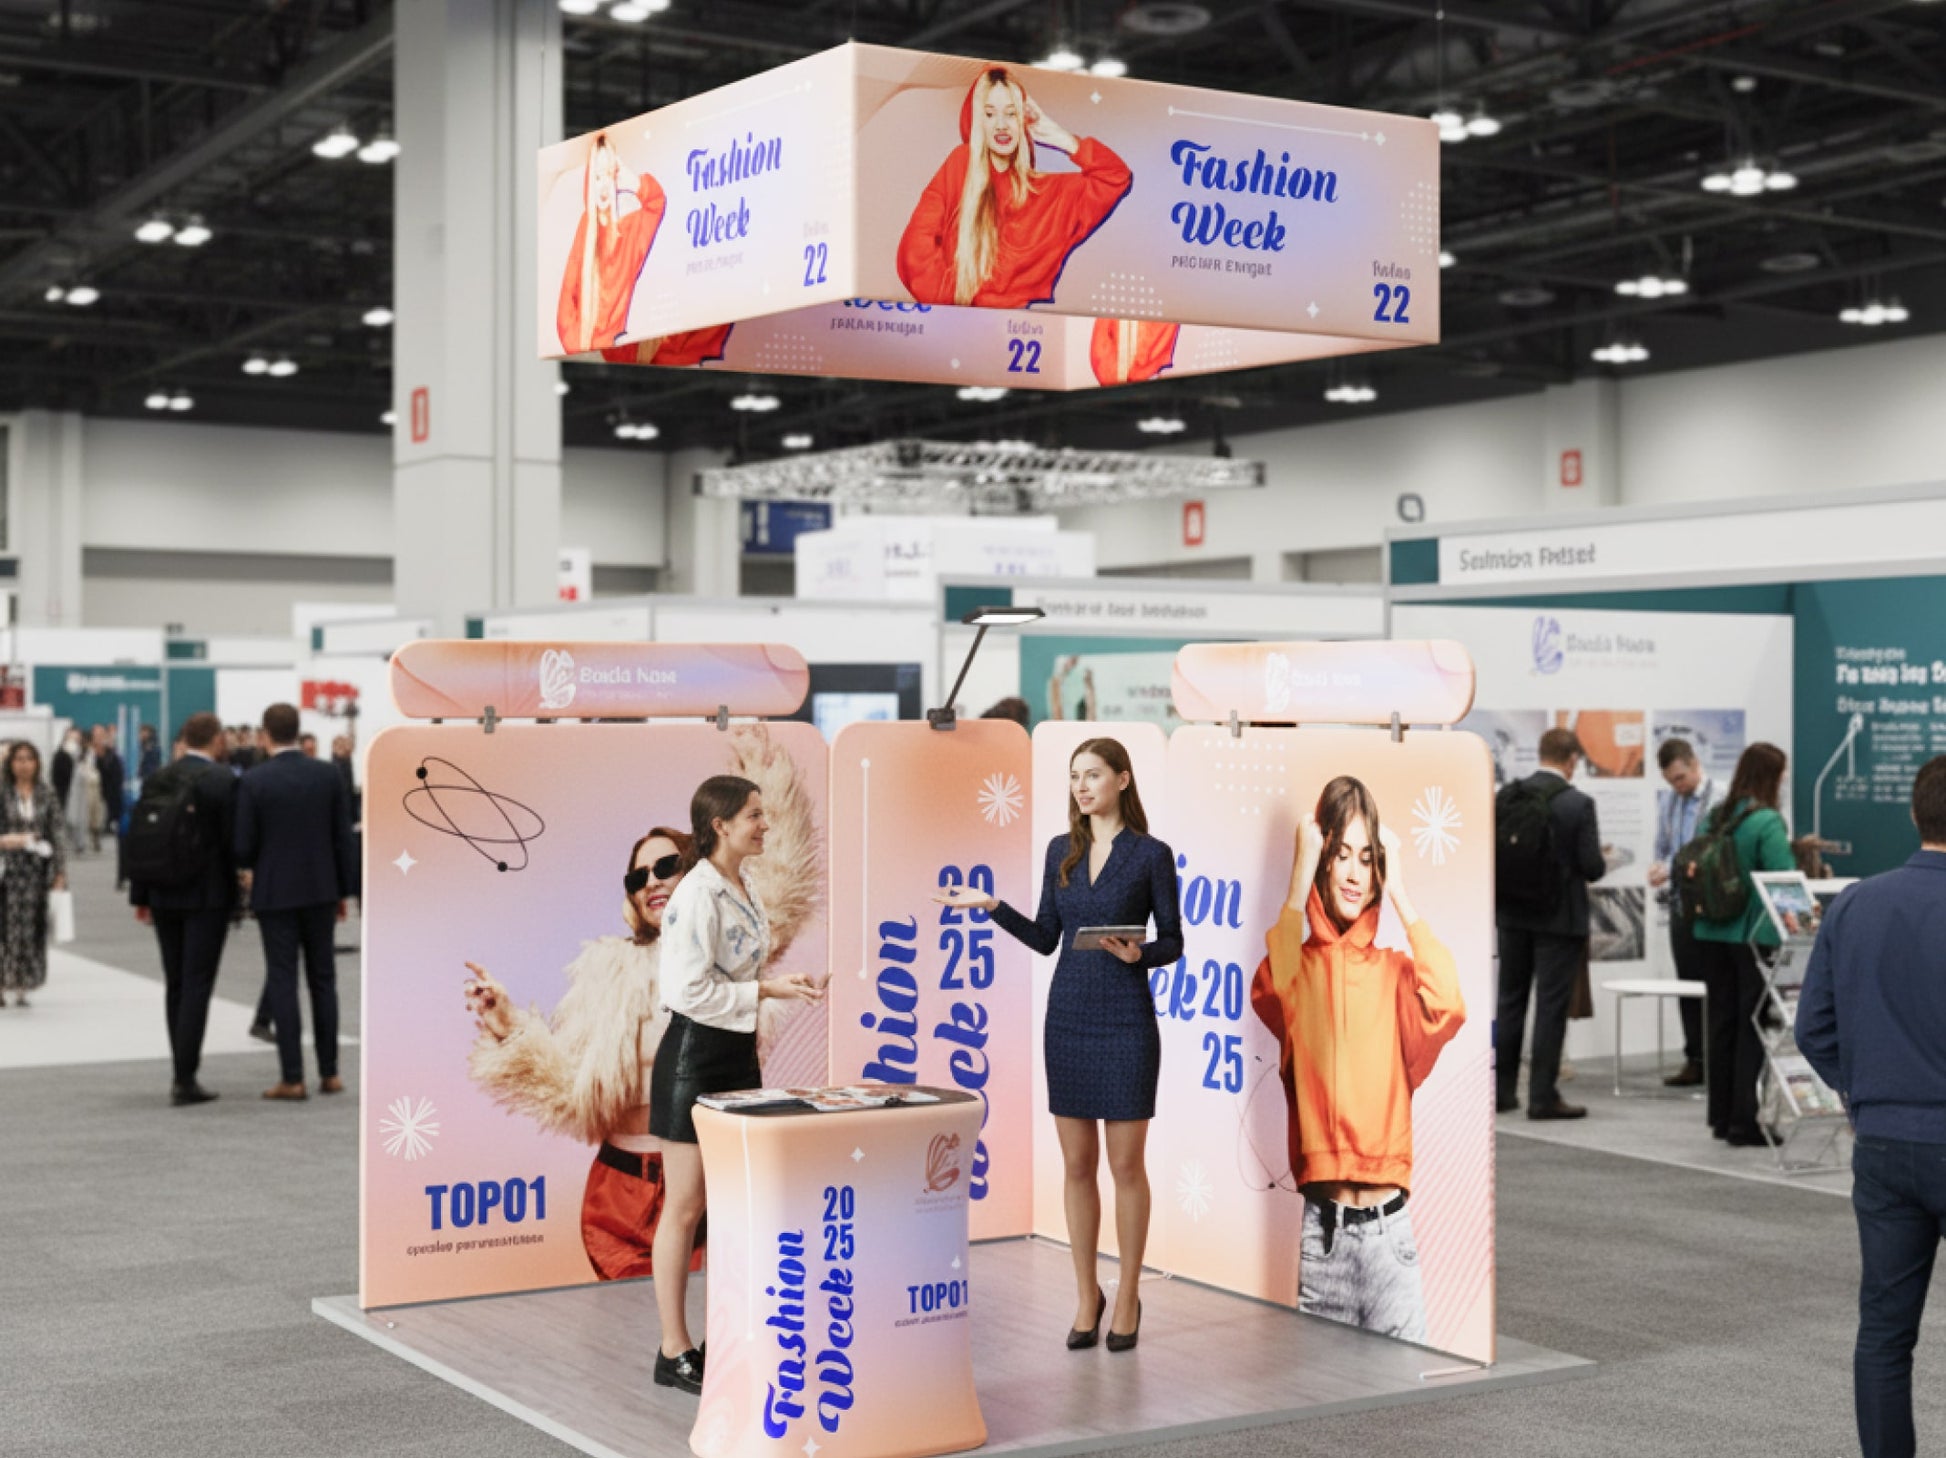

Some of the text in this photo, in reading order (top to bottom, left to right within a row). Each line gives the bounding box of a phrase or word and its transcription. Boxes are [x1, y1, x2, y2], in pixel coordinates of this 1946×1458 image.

[687, 130, 781, 192] Fashion
[1170, 139, 1337, 207] Fashion
[687, 198, 750, 247] Week
[1171, 201, 1286, 252] Week
[803, 242, 827, 286] 22
[1373, 283, 1410, 323] 22
[1009, 340, 1040, 372] 22
[939, 928, 995, 990] 25
[1201, 959, 1243, 1022] 20
[1202, 1031, 1244, 1094] 25
[822, 1186, 855, 1225] 20
[823, 1220, 856, 1262] 25
[763, 1229, 807, 1440] Fashion
[815, 1267, 854, 1433] Week
